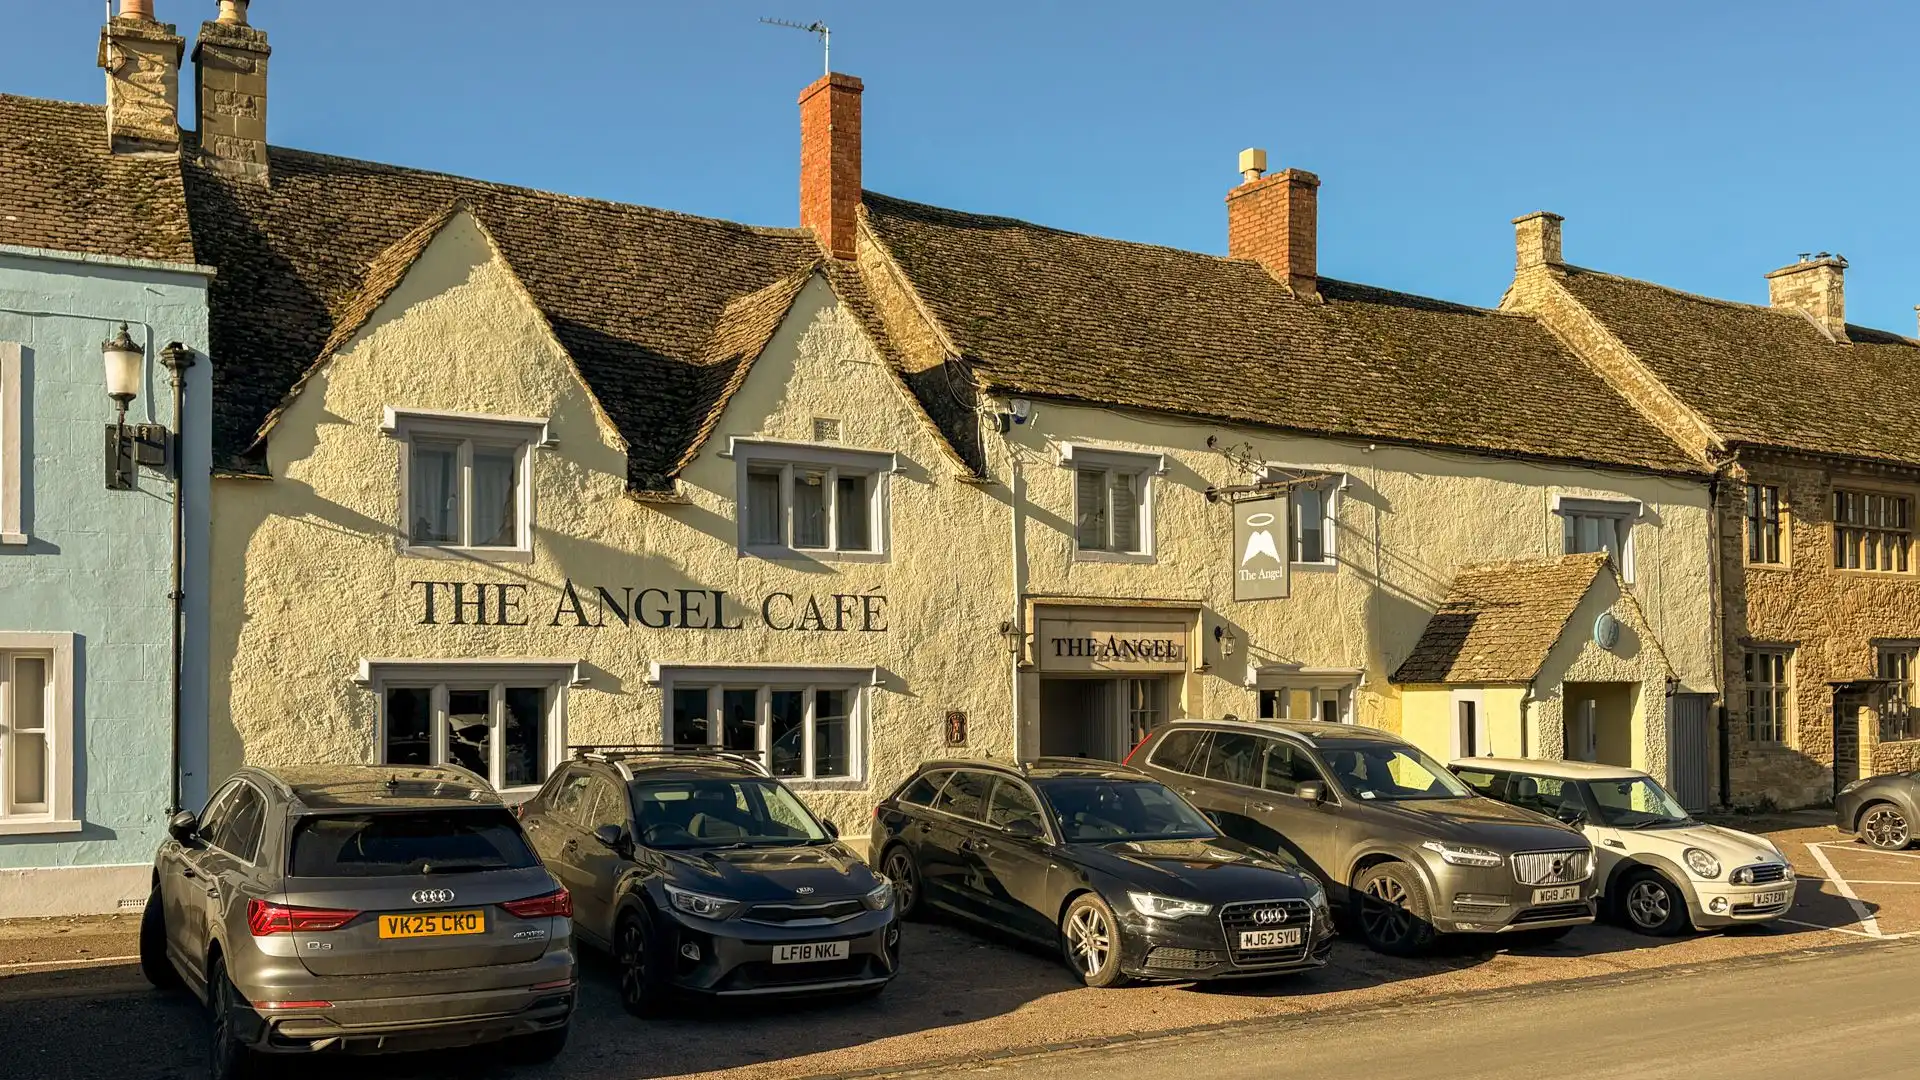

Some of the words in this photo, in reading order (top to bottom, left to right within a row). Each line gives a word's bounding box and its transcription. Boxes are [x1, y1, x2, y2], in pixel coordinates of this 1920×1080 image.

[1239, 569, 1256, 581] The
[1258, 566, 1283, 581] Angel
[410, 581, 529, 626] THE
[547, 577, 744, 630] ANGEL
[762, 585, 889, 632] CAFÉ
[1051, 638, 1098, 657] THE
[1104, 634, 1178, 658] ANGEL
[388, 916, 436, 934] VK25
[307, 941, 332, 950] Q3
[1245, 932, 1275, 946] MJ62
[1277, 930, 1297, 944] SYU
[780, 945, 812, 961] LF18
[815, 943, 841, 958] NKL
